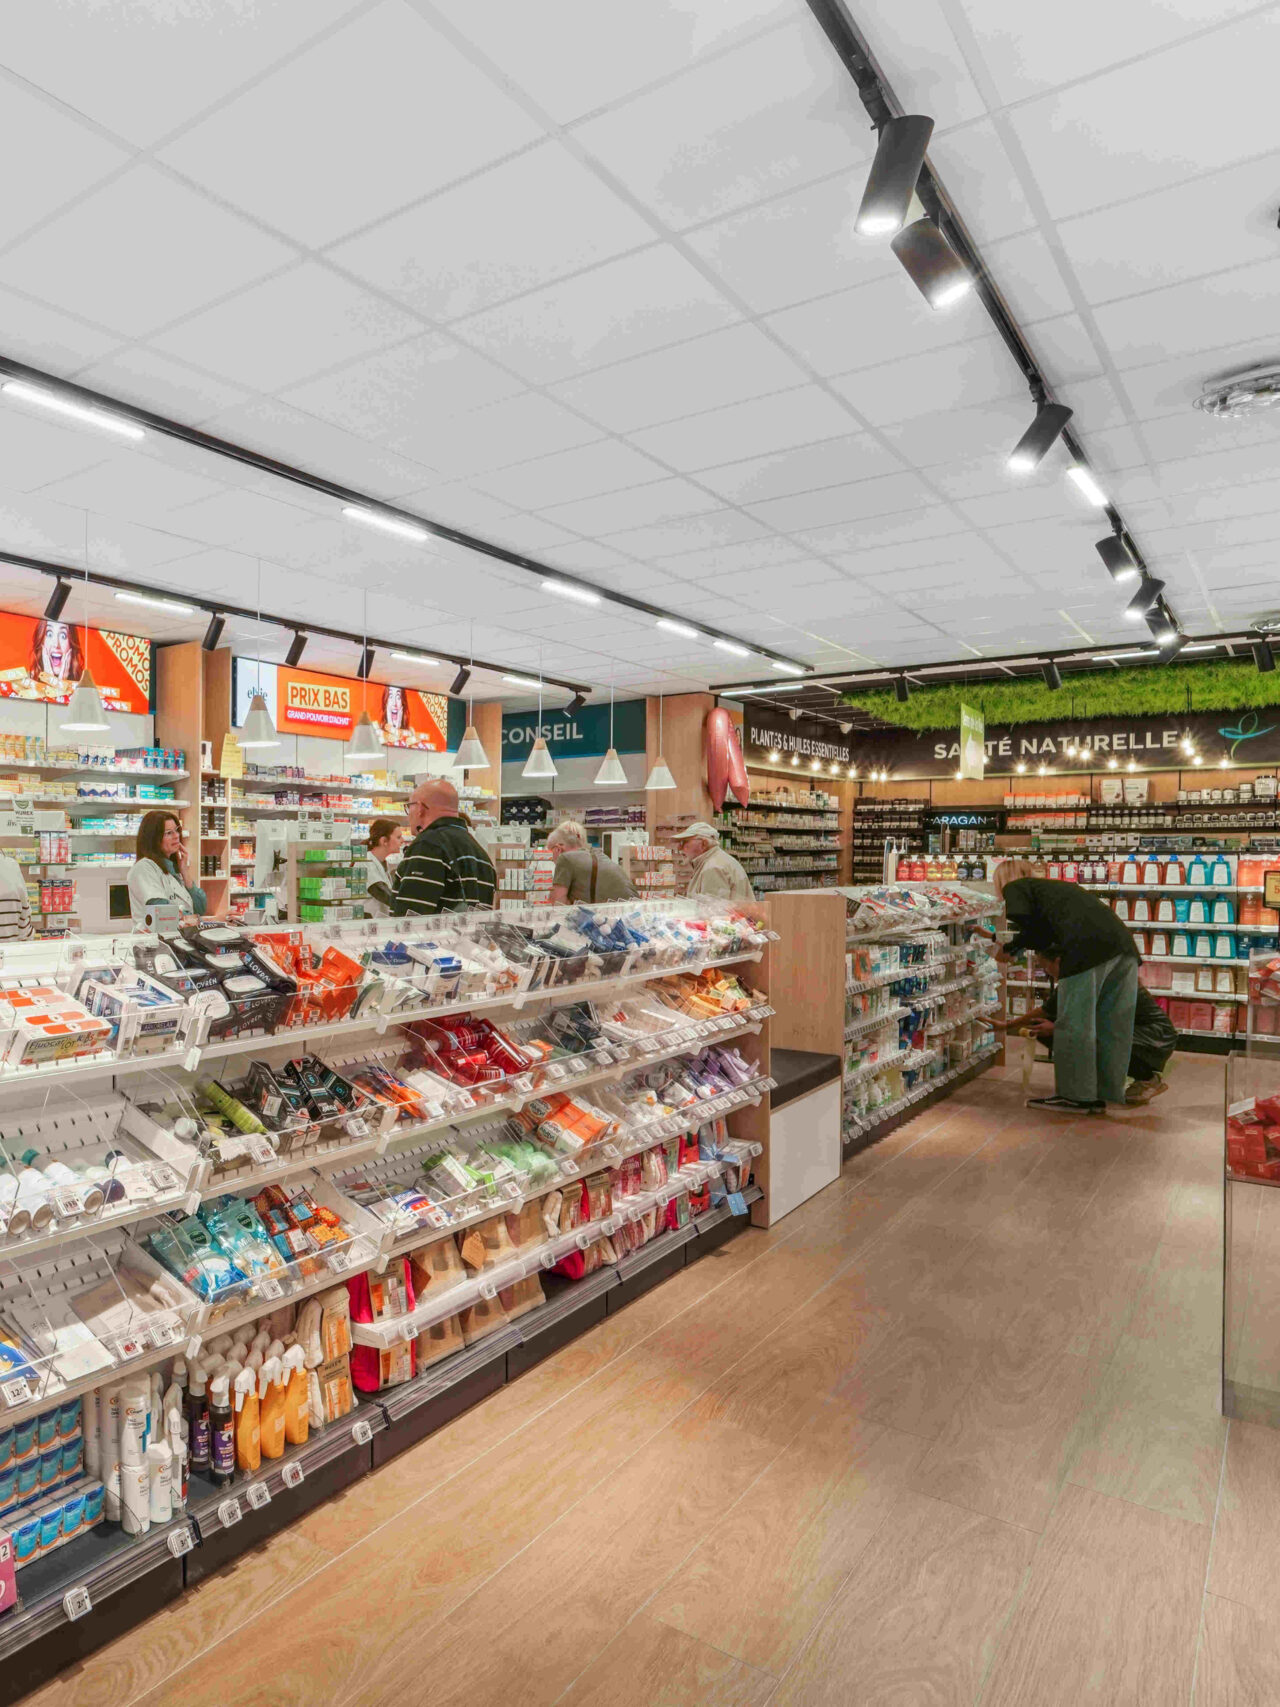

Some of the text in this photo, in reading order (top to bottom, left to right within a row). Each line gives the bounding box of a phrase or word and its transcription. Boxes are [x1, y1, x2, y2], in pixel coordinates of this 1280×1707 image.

[290, 686, 348, 709] PRIX BAS
[287, 710, 306, 719] GRAND
[751, 727, 849, 761] PLANTES & HUILES ESSENTIELLES
[934, 730, 1177, 759] SATÉ NATURELLE
[933, 816, 986, 824] ARAGAN
[1, 1546, 8, 1557] 2
